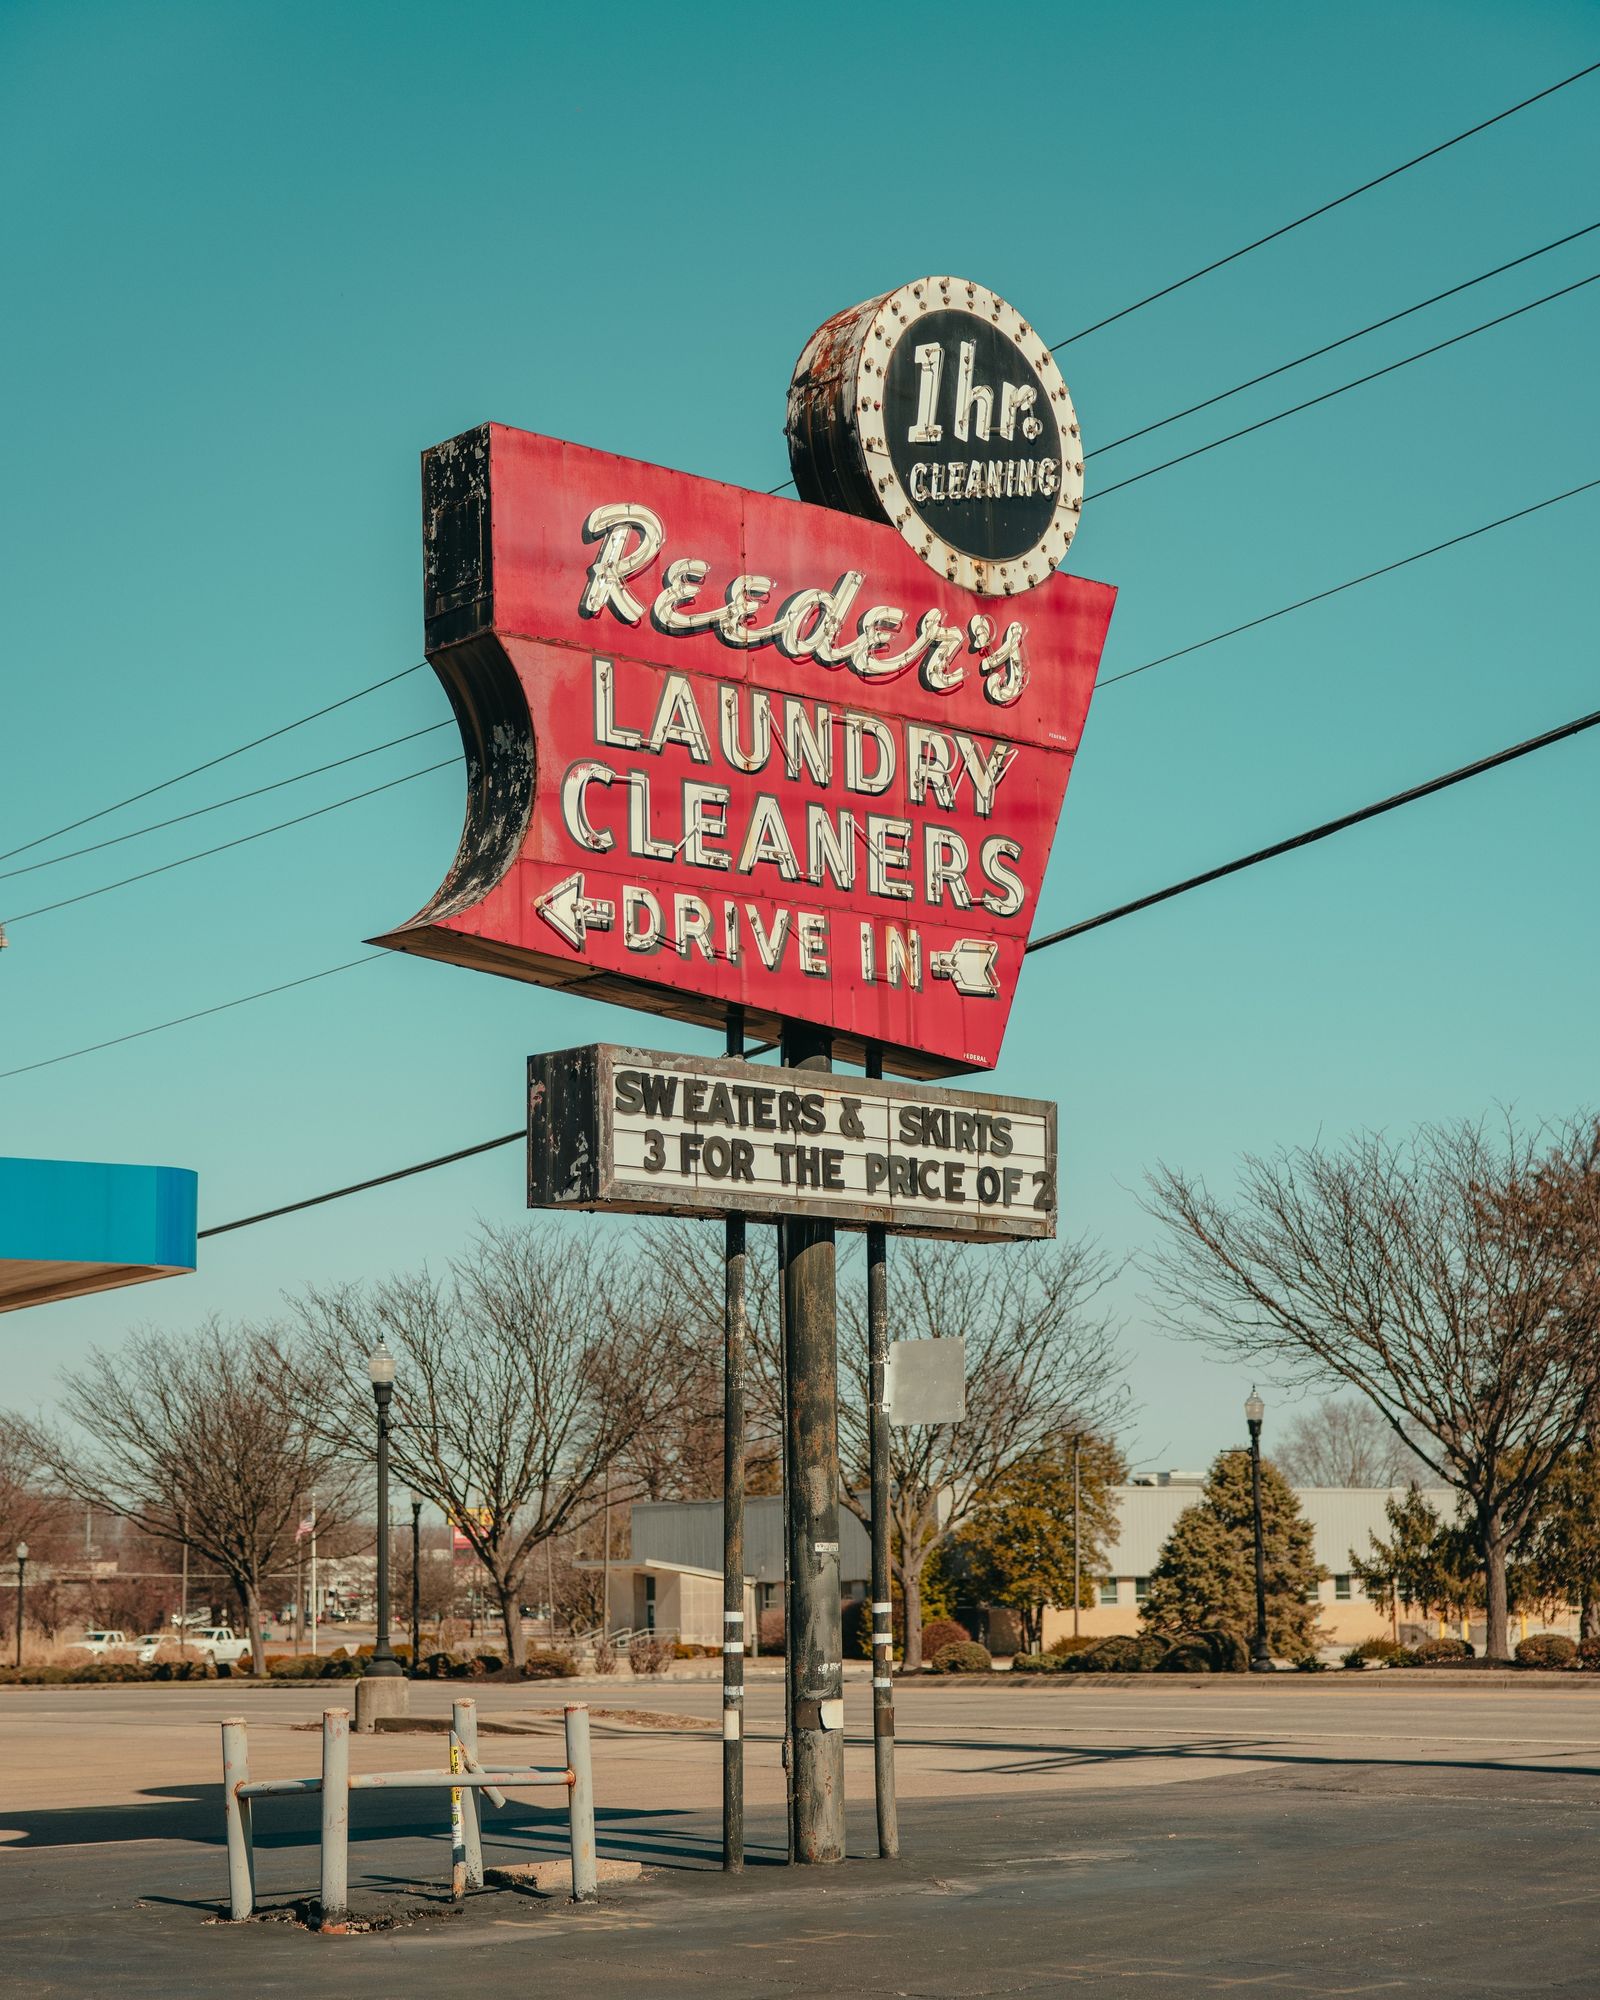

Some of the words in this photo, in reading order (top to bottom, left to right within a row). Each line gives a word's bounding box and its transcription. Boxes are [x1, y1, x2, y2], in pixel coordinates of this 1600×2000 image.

[910, 457, 1061, 502] CLEANING
[579, 502, 1030, 705] Reeder's
[593, 657, 1017, 816] LAUNDRY
[1048, 732, 1067, 742] FEDERAL
[562, 760, 1025, 917] CLEANERS
[622, 885, 829, 974] DRIVE
[859, 920, 923, 992] IN
[963, 1052, 987, 1063] FEDERAL
[615, 1070, 826, 1135] SWEATERS
[839, 1097, 865, 1138] &
[899, 1105, 1013, 1158] SKIRTS
[644, 1130, 666, 1172] 3
[680, 1132, 755, 1182] FOR
[774, 1142, 846, 1190] THE
[866, 1152, 966, 1203] PRICE
[977, 1166, 1023, 1209] OF
[1032, 1170, 1054, 1211] 2
